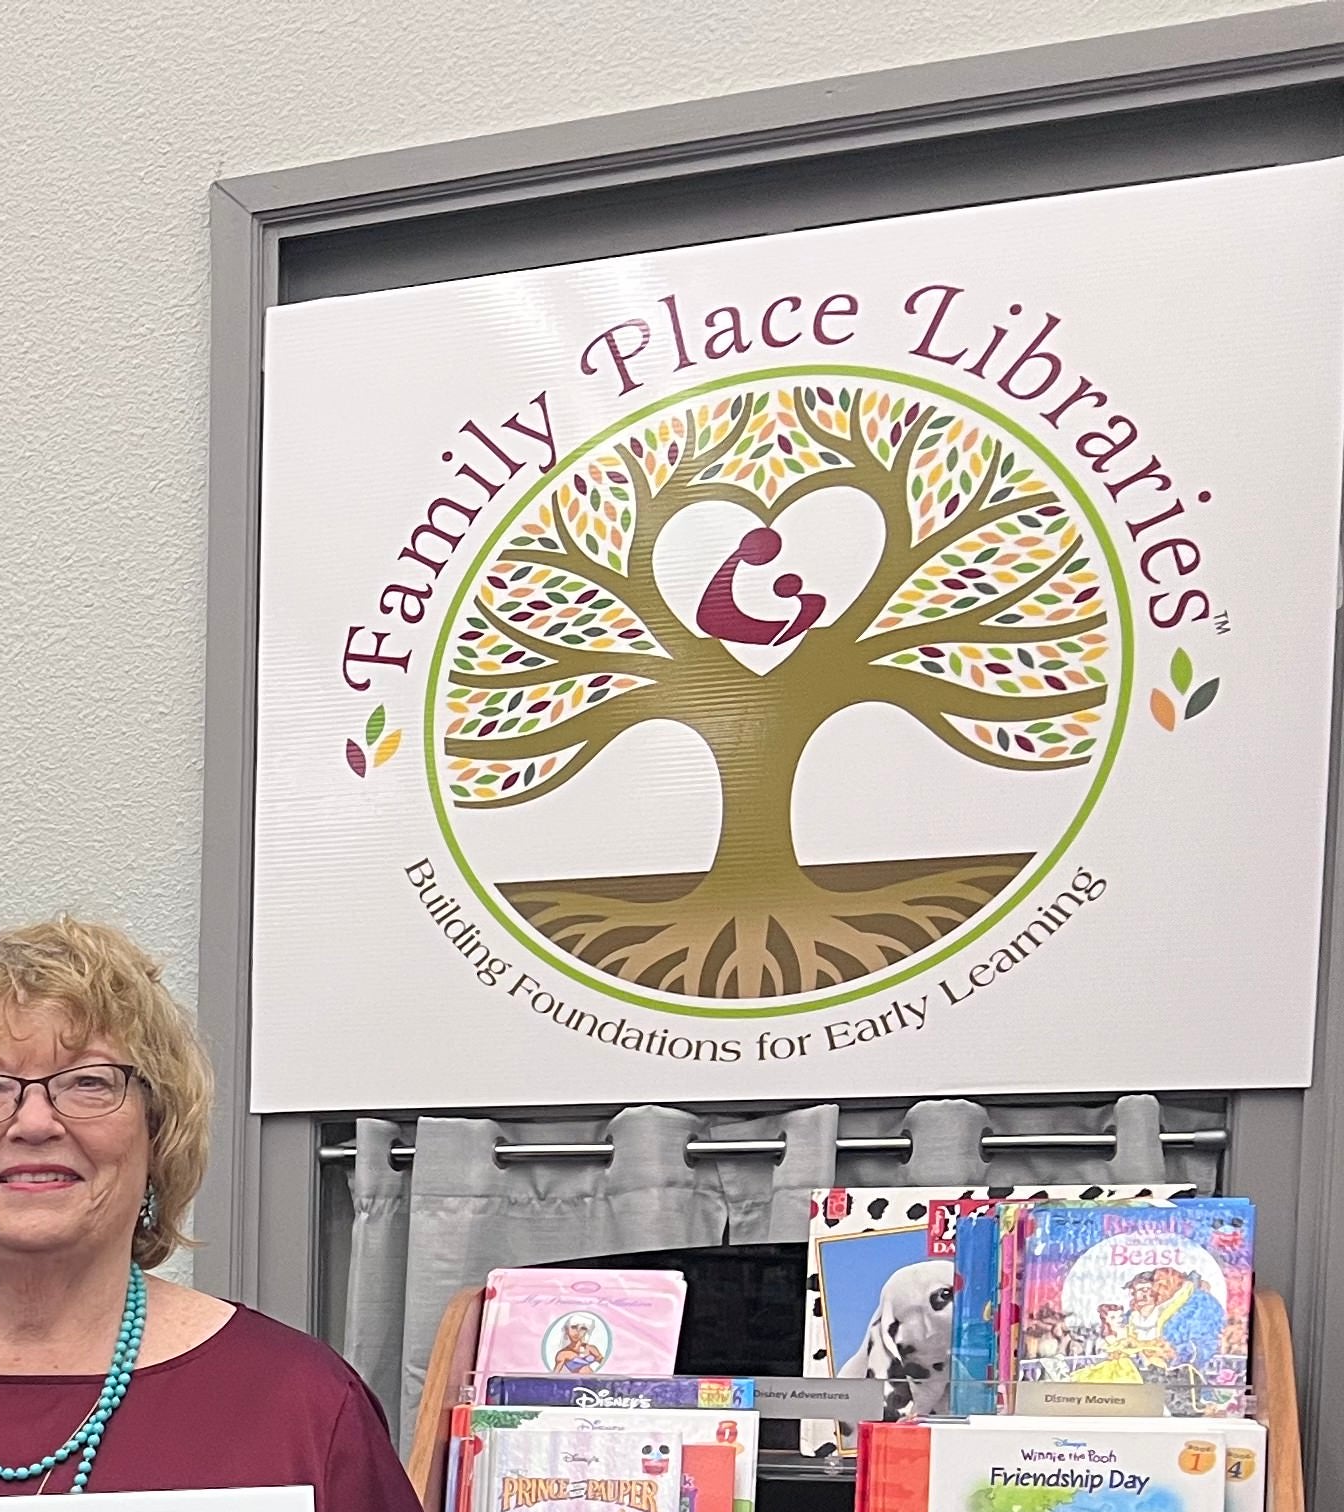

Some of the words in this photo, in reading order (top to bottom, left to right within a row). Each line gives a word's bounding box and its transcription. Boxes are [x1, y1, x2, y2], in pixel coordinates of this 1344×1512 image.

[340, 388, 559, 693] Family
[579, 289, 862, 397] Place
[903, 282, 1212, 634] Libraries
[402, 855, 511, 988] Building
[504, 970, 742, 1065] Foundations
[753, 1026, 814, 1062] for
[822, 991, 933, 1056] Early
[933, 864, 1110, 1007] Learning
[1110, 1245, 1184, 1266] Beast
[790, 1389, 850, 1401] Adventures
[1044, 1394, 1081, 1406] Disney
[1085, 1394, 1126, 1405] Movies
[1021, 1449, 1065, 1462] Winnie
[1088, 1450, 1117, 1463] Pooh
[1227, 1461, 1242, 1478] 4
[991, 1467, 1103, 1493] Friendship
[1109, 1470, 1150, 1495] Day
[501, 1477, 569, 1512] PRINCE
